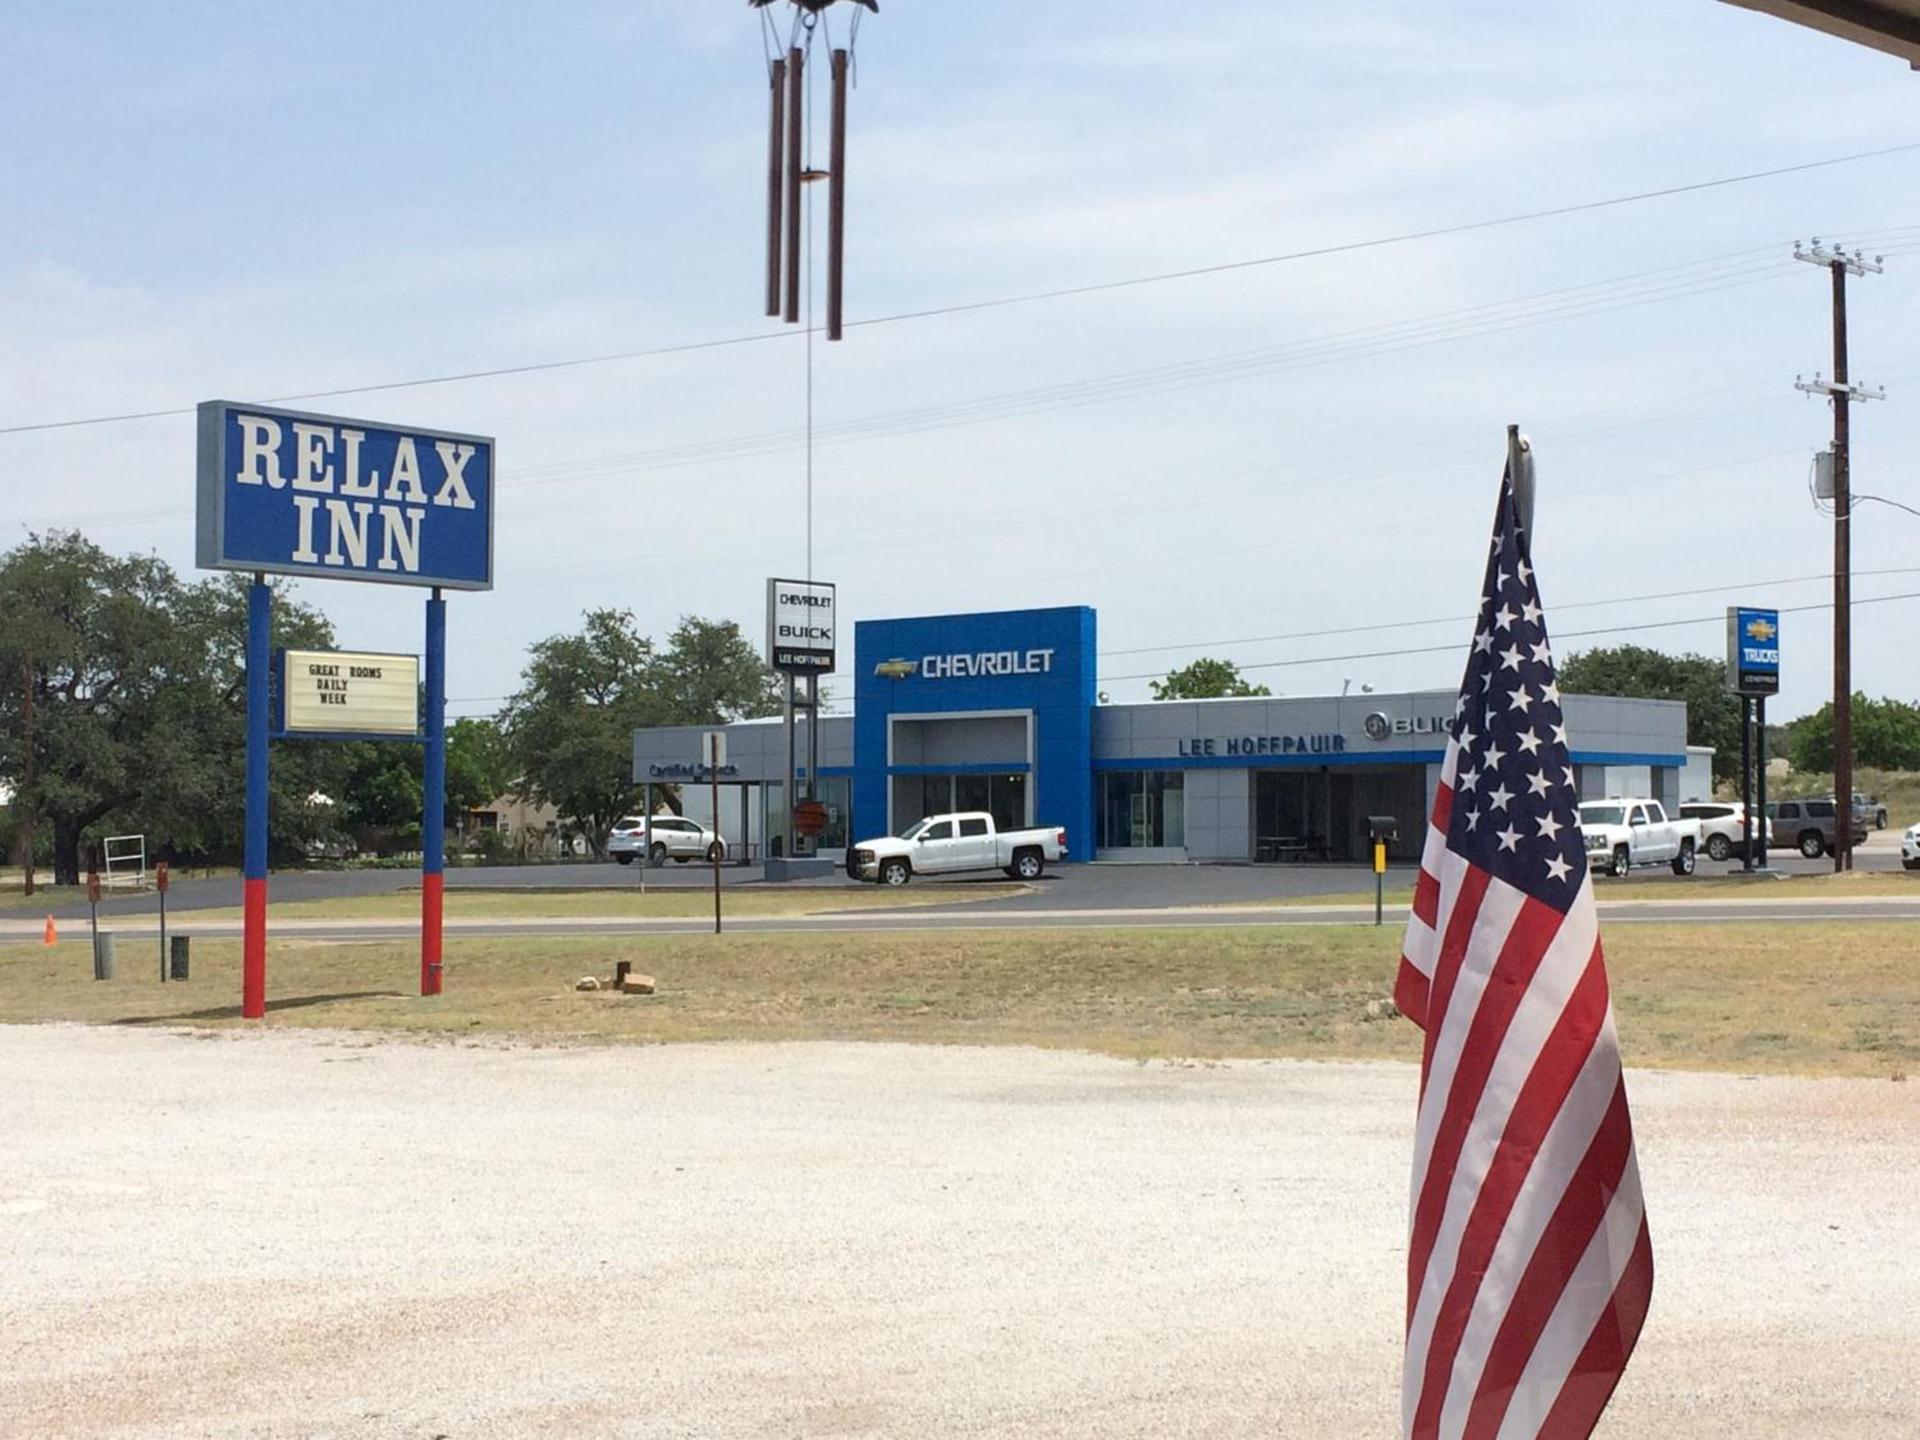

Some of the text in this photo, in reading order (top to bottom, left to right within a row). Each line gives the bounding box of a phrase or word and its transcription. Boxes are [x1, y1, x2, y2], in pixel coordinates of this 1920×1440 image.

[236, 413, 476, 510] RELAX
[292, 495, 426, 572] INN
[779, 593, 832, 608] CHEVROLET
[779, 625, 832, 640] BUICK
[308, 664, 382, 678] GREAT ROOMS
[922, 649, 1054, 678] CHEVROLET
[317, 679, 348, 691] DAILY
[320, 693, 347, 705] WEEK
[1392, 716, 1455, 734] BUIC
[1179, 734, 1346, 756] LEE HOFFPAUIR
